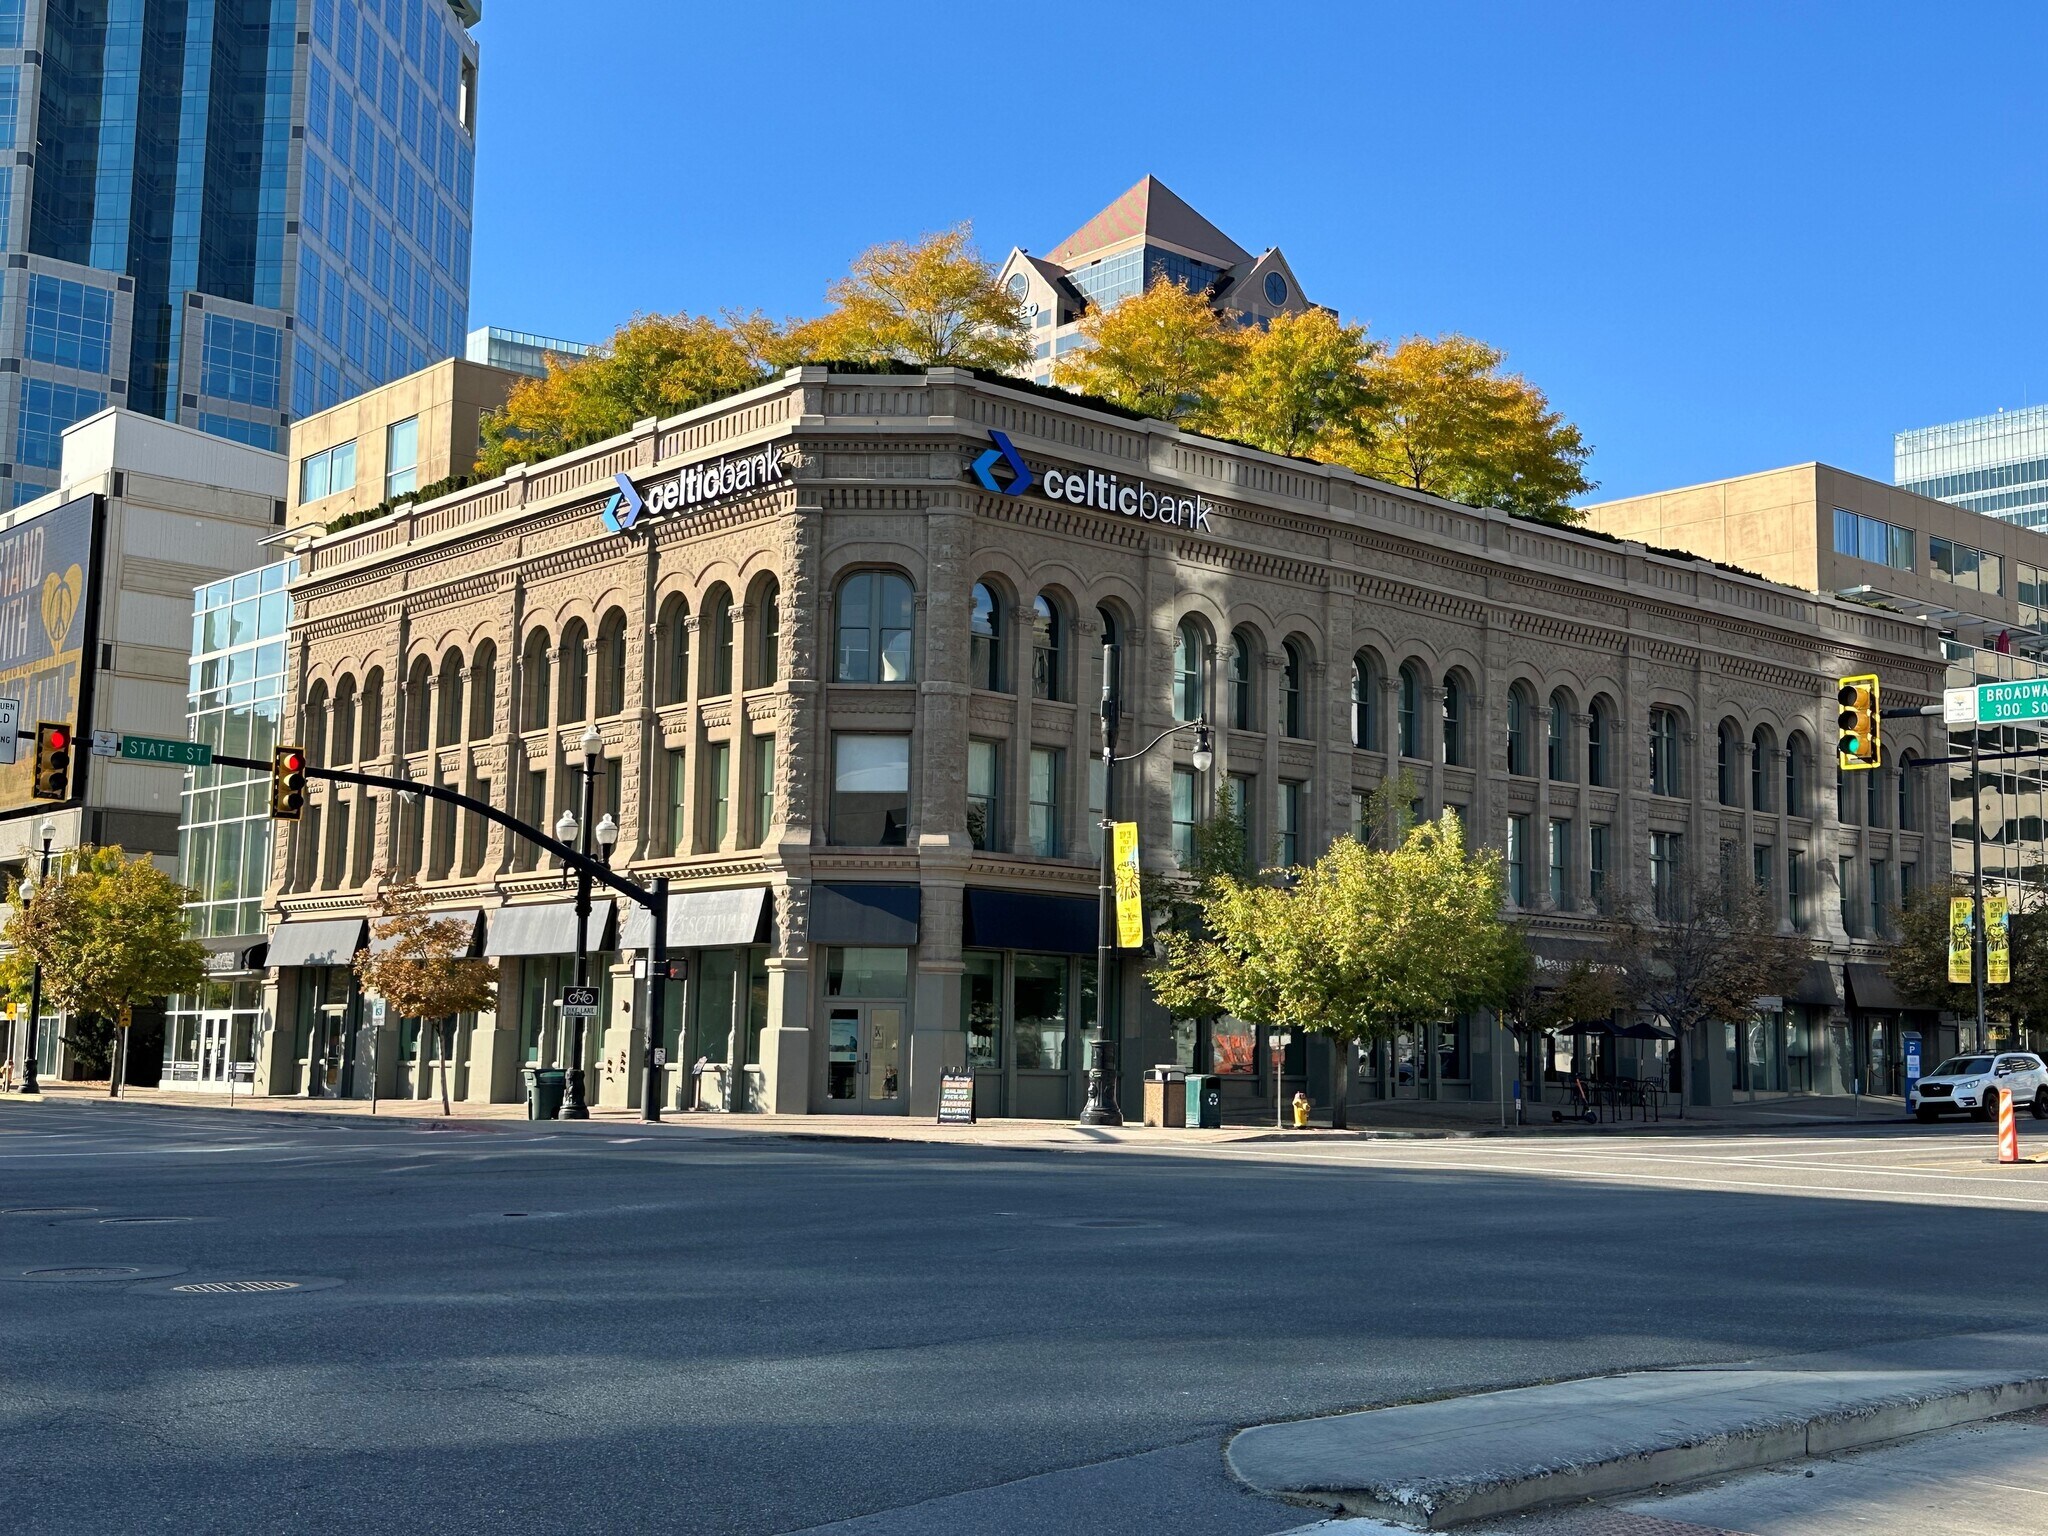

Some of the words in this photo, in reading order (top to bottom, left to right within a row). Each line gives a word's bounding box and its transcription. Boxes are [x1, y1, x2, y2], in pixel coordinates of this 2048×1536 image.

[649, 443, 783, 514] celticbank
[1043, 469, 1212, 533] celticbank
[1994, 702, 2020, 717] 300
[129, 740, 175, 758] STATE
[1910, 1045, 1916, 1054] P
